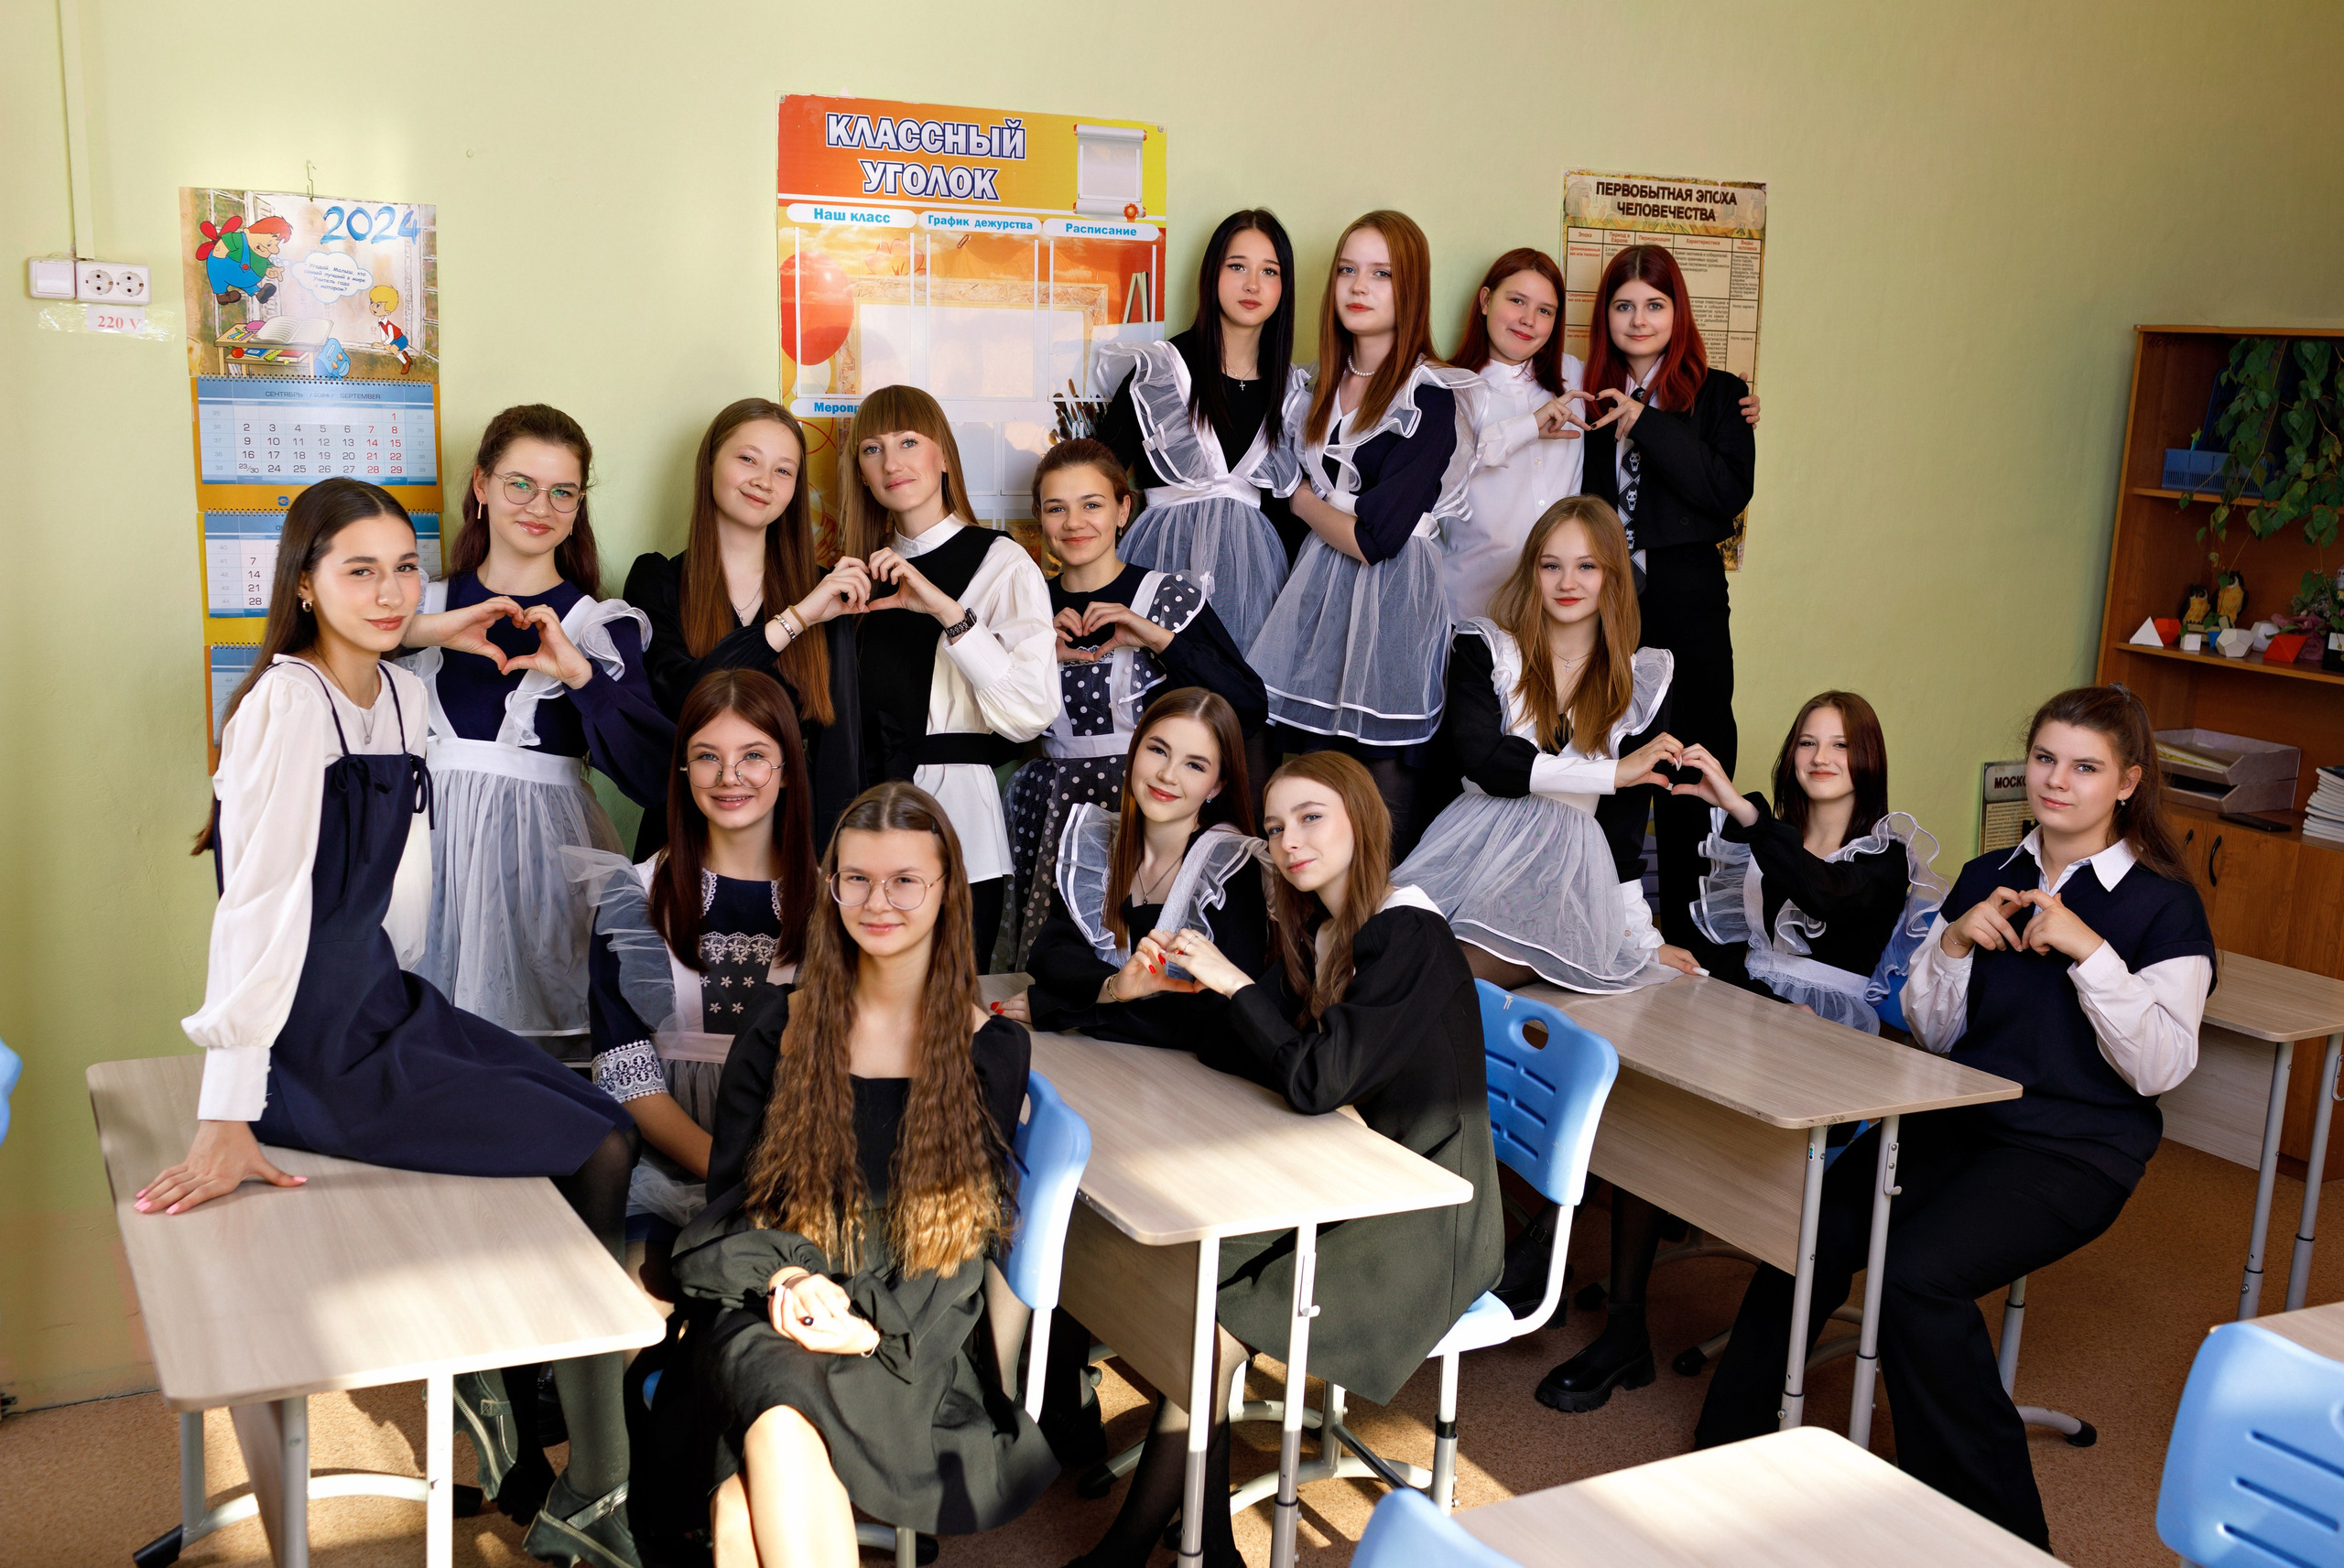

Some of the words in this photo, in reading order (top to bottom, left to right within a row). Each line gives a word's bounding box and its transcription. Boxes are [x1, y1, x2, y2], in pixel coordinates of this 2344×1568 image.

[826, 113, 1026, 160] КЛАССНЫЙ
[859, 159, 1000, 200] УГОЛОК
[1596, 181, 1692, 201] ПЕРВОБЫТНАЯ
[1696, 189, 1737, 205] ЭПОХА
[814, 208, 846, 221] Наш
[850, 210, 891, 223] класс
[1617, 201, 1716, 222] ЧЕЛОВЕЧЕСТВА
[320, 206, 422, 244] 2024
[928, 214, 970, 227] График
[974, 218, 1033, 231] дежурства
[1065, 222, 1137, 237] Расписание
[97, 315, 124, 329] 220
[129, 318, 141, 330] V
[391, 413, 396, 421] 1
[244, 423, 250, 432] 2
[269, 424, 277, 432] 3
[320, 425, 327, 433] 5
[344, 425, 351, 433] 6
[368, 426, 374, 434] 7
[391, 426, 398, 434] 8
[244, 437, 251, 446] 9
[267, 438, 280, 446] 10
[293, 438, 304, 446] 11
[318, 438, 331, 447] 12
[342, 438, 354, 447] 13
[390, 439, 402, 448] 15
[242, 450, 255, 460] 16
[267, 451, 280, 460] 17
[293, 451, 306, 460] 18
[318, 451, 331, 460] 19
[342, 452, 355, 460] 20
[366, 452, 378, 460] 21
[389, 452, 402, 460] 22
[238, 463, 259, 474] 23/30
[267, 464, 281, 473] 24
[293, 465, 307, 473] 25
[318, 465, 331, 473] 26
[342, 465, 355, 473] 27
[390, 466, 403, 474] 29
[250, 557, 256, 565] 7
[248, 570, 261, 579] 14
[248, 584, 260, 592] 21
[248, 598, 262, 606] 28
